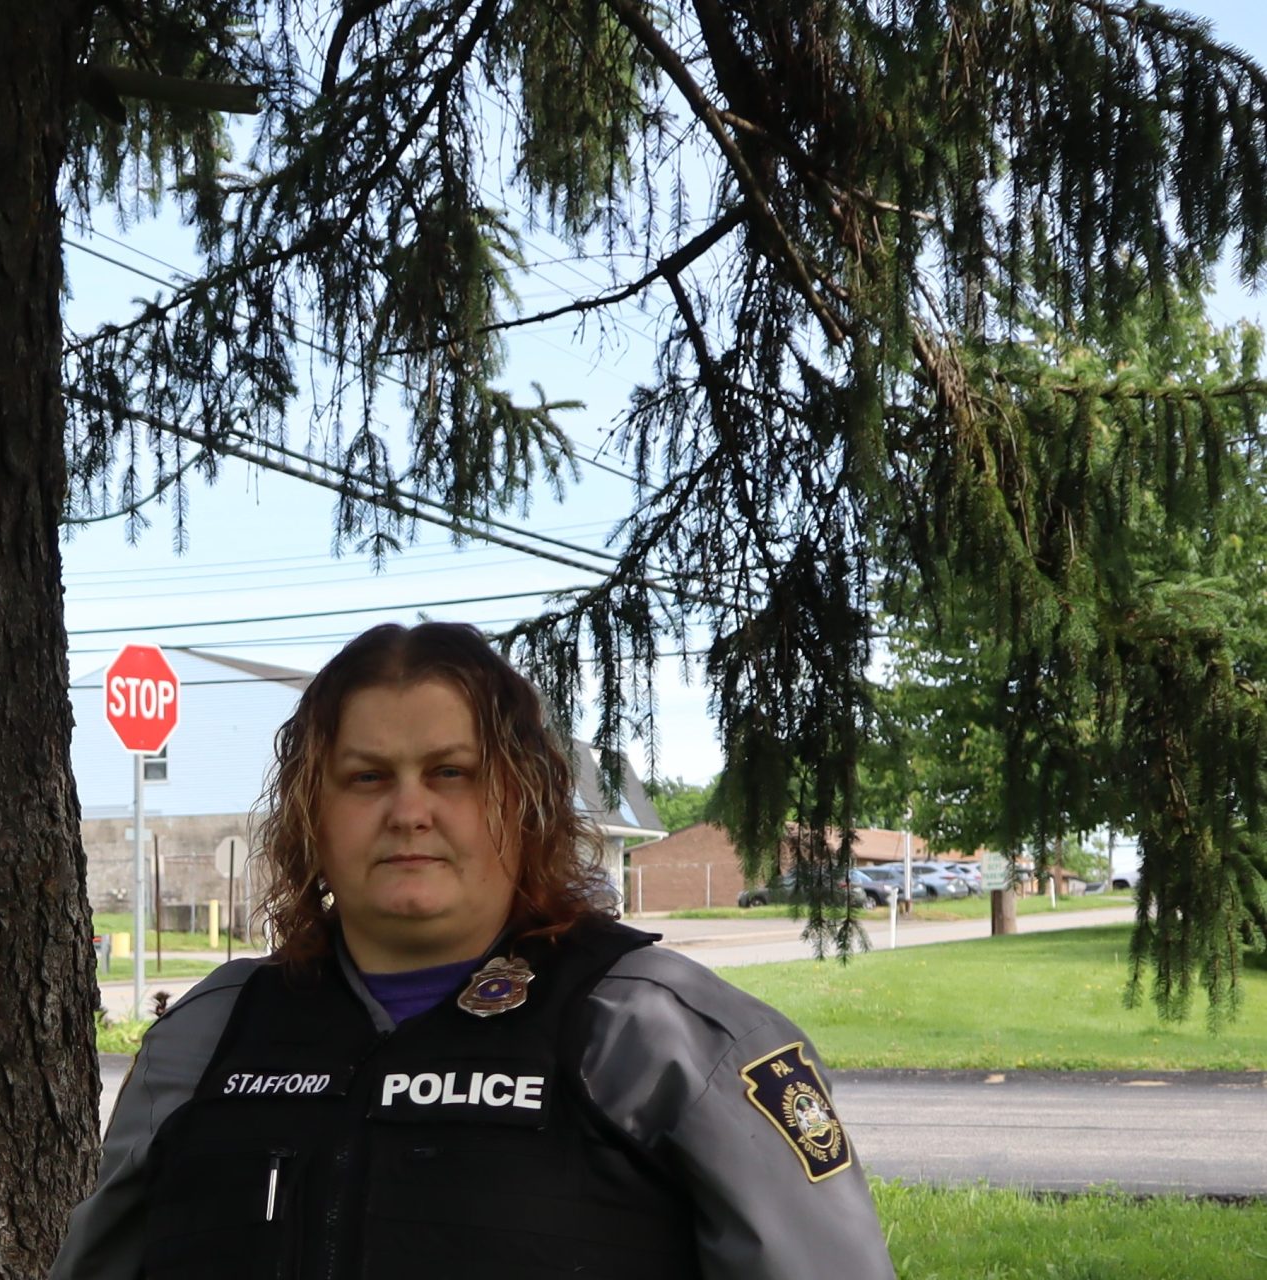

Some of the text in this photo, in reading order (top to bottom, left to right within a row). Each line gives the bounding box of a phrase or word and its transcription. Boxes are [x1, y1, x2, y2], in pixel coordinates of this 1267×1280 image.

[109, 675, 175, 720] STOP
[223, 1073, 330, 1094] STAFFORD
[381, 1072, 545, 1109] POLICE
[797, 1135, 828, 1162] POLICE
